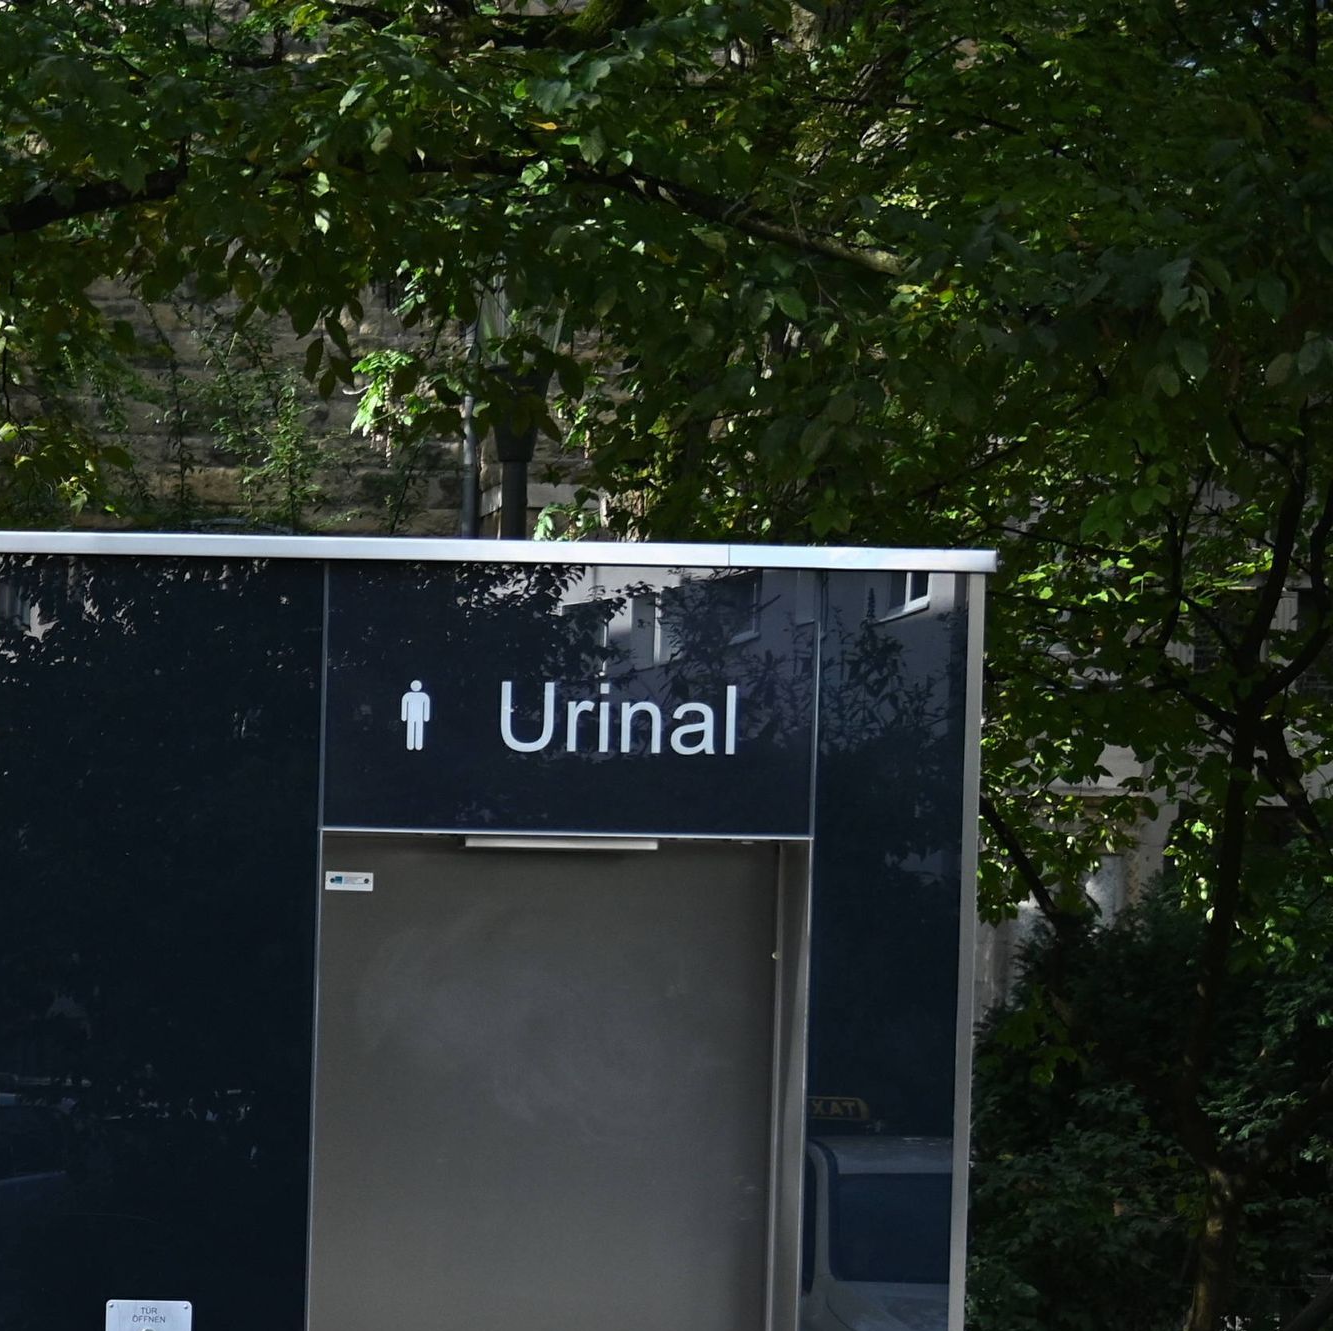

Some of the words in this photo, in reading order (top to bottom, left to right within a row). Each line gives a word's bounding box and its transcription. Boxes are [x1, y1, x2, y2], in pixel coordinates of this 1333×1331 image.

[500, 680, 737, 755] Urinal
[141, 1306, 158, 1315] TÜR
[132, 1314, 166, 1323] ÖFFNEN
